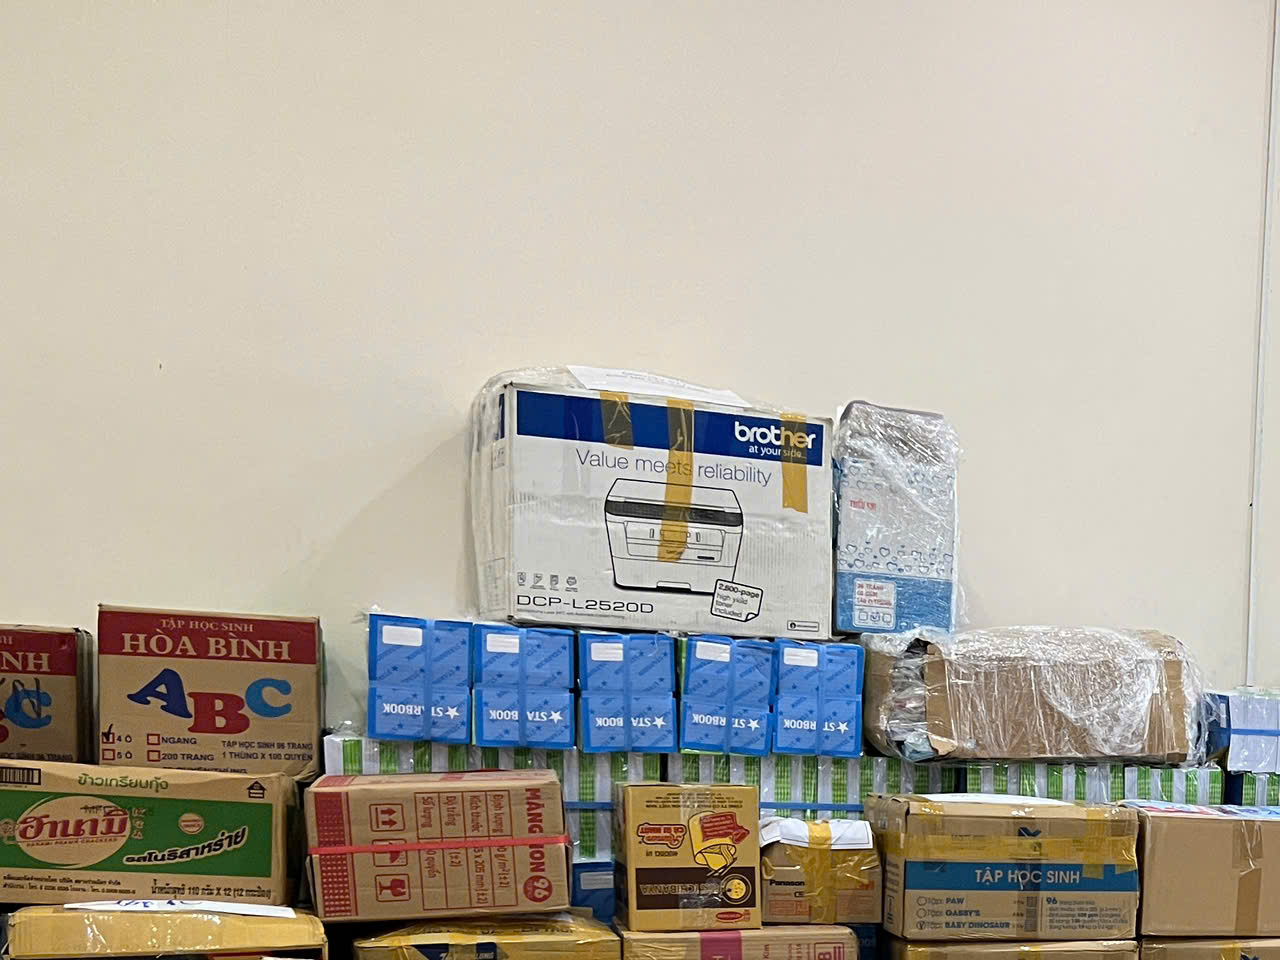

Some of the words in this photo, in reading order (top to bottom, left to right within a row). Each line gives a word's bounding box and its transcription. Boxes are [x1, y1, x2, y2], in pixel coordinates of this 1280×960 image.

[733, 421, 817, 450] brother
[760, 446, 781, 458] your
[576, 448, 629, 470] Value
[636, 457, 692, 475] meets
[697, 463, 772, 487] reliability
[516, 593, 654, 614] DCP-L2520D
[222, 622, 254, 632] SINH
[121, 627, 197, 656] HÒA
[207, 631, 292, 661] BÌNH
[127, 667, 292, 734] ABC
[161, 736, 197, 745] NGANG
[180, 753, 214, 762] TRANG
[975, 868, 1003, 886] TẬP
[1008, 869, 1042, 887] HỌC
[1047, 869, 1080, 884] SINH
